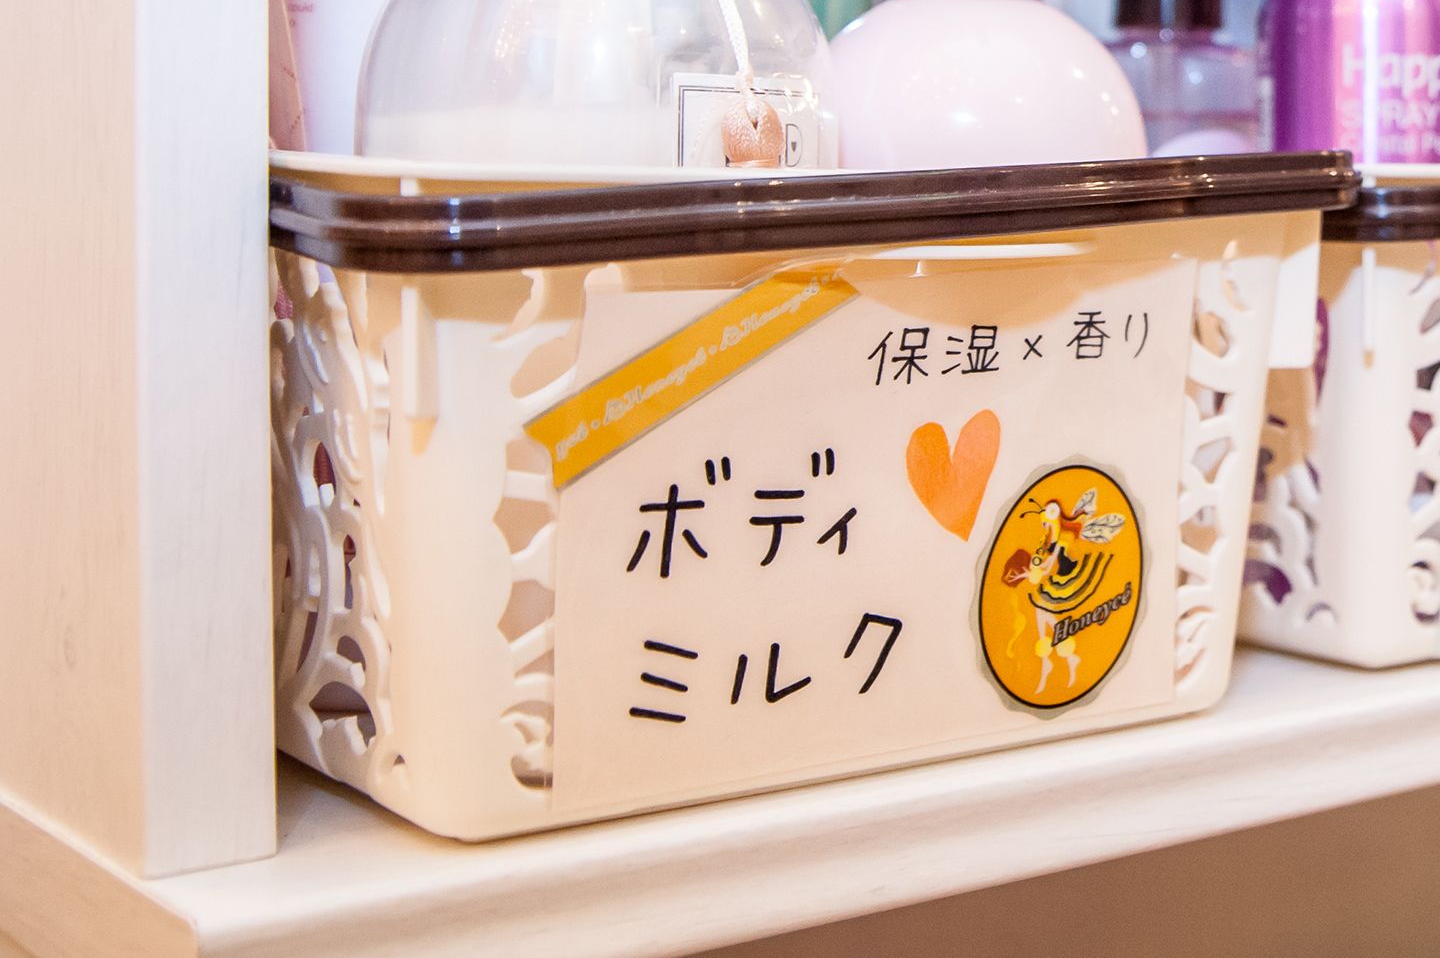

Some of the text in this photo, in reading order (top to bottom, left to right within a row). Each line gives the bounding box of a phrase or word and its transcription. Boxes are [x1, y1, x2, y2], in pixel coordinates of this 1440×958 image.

[625, 447, 858, 579] ボディ
[628, 611, 903, 723] ミルク
